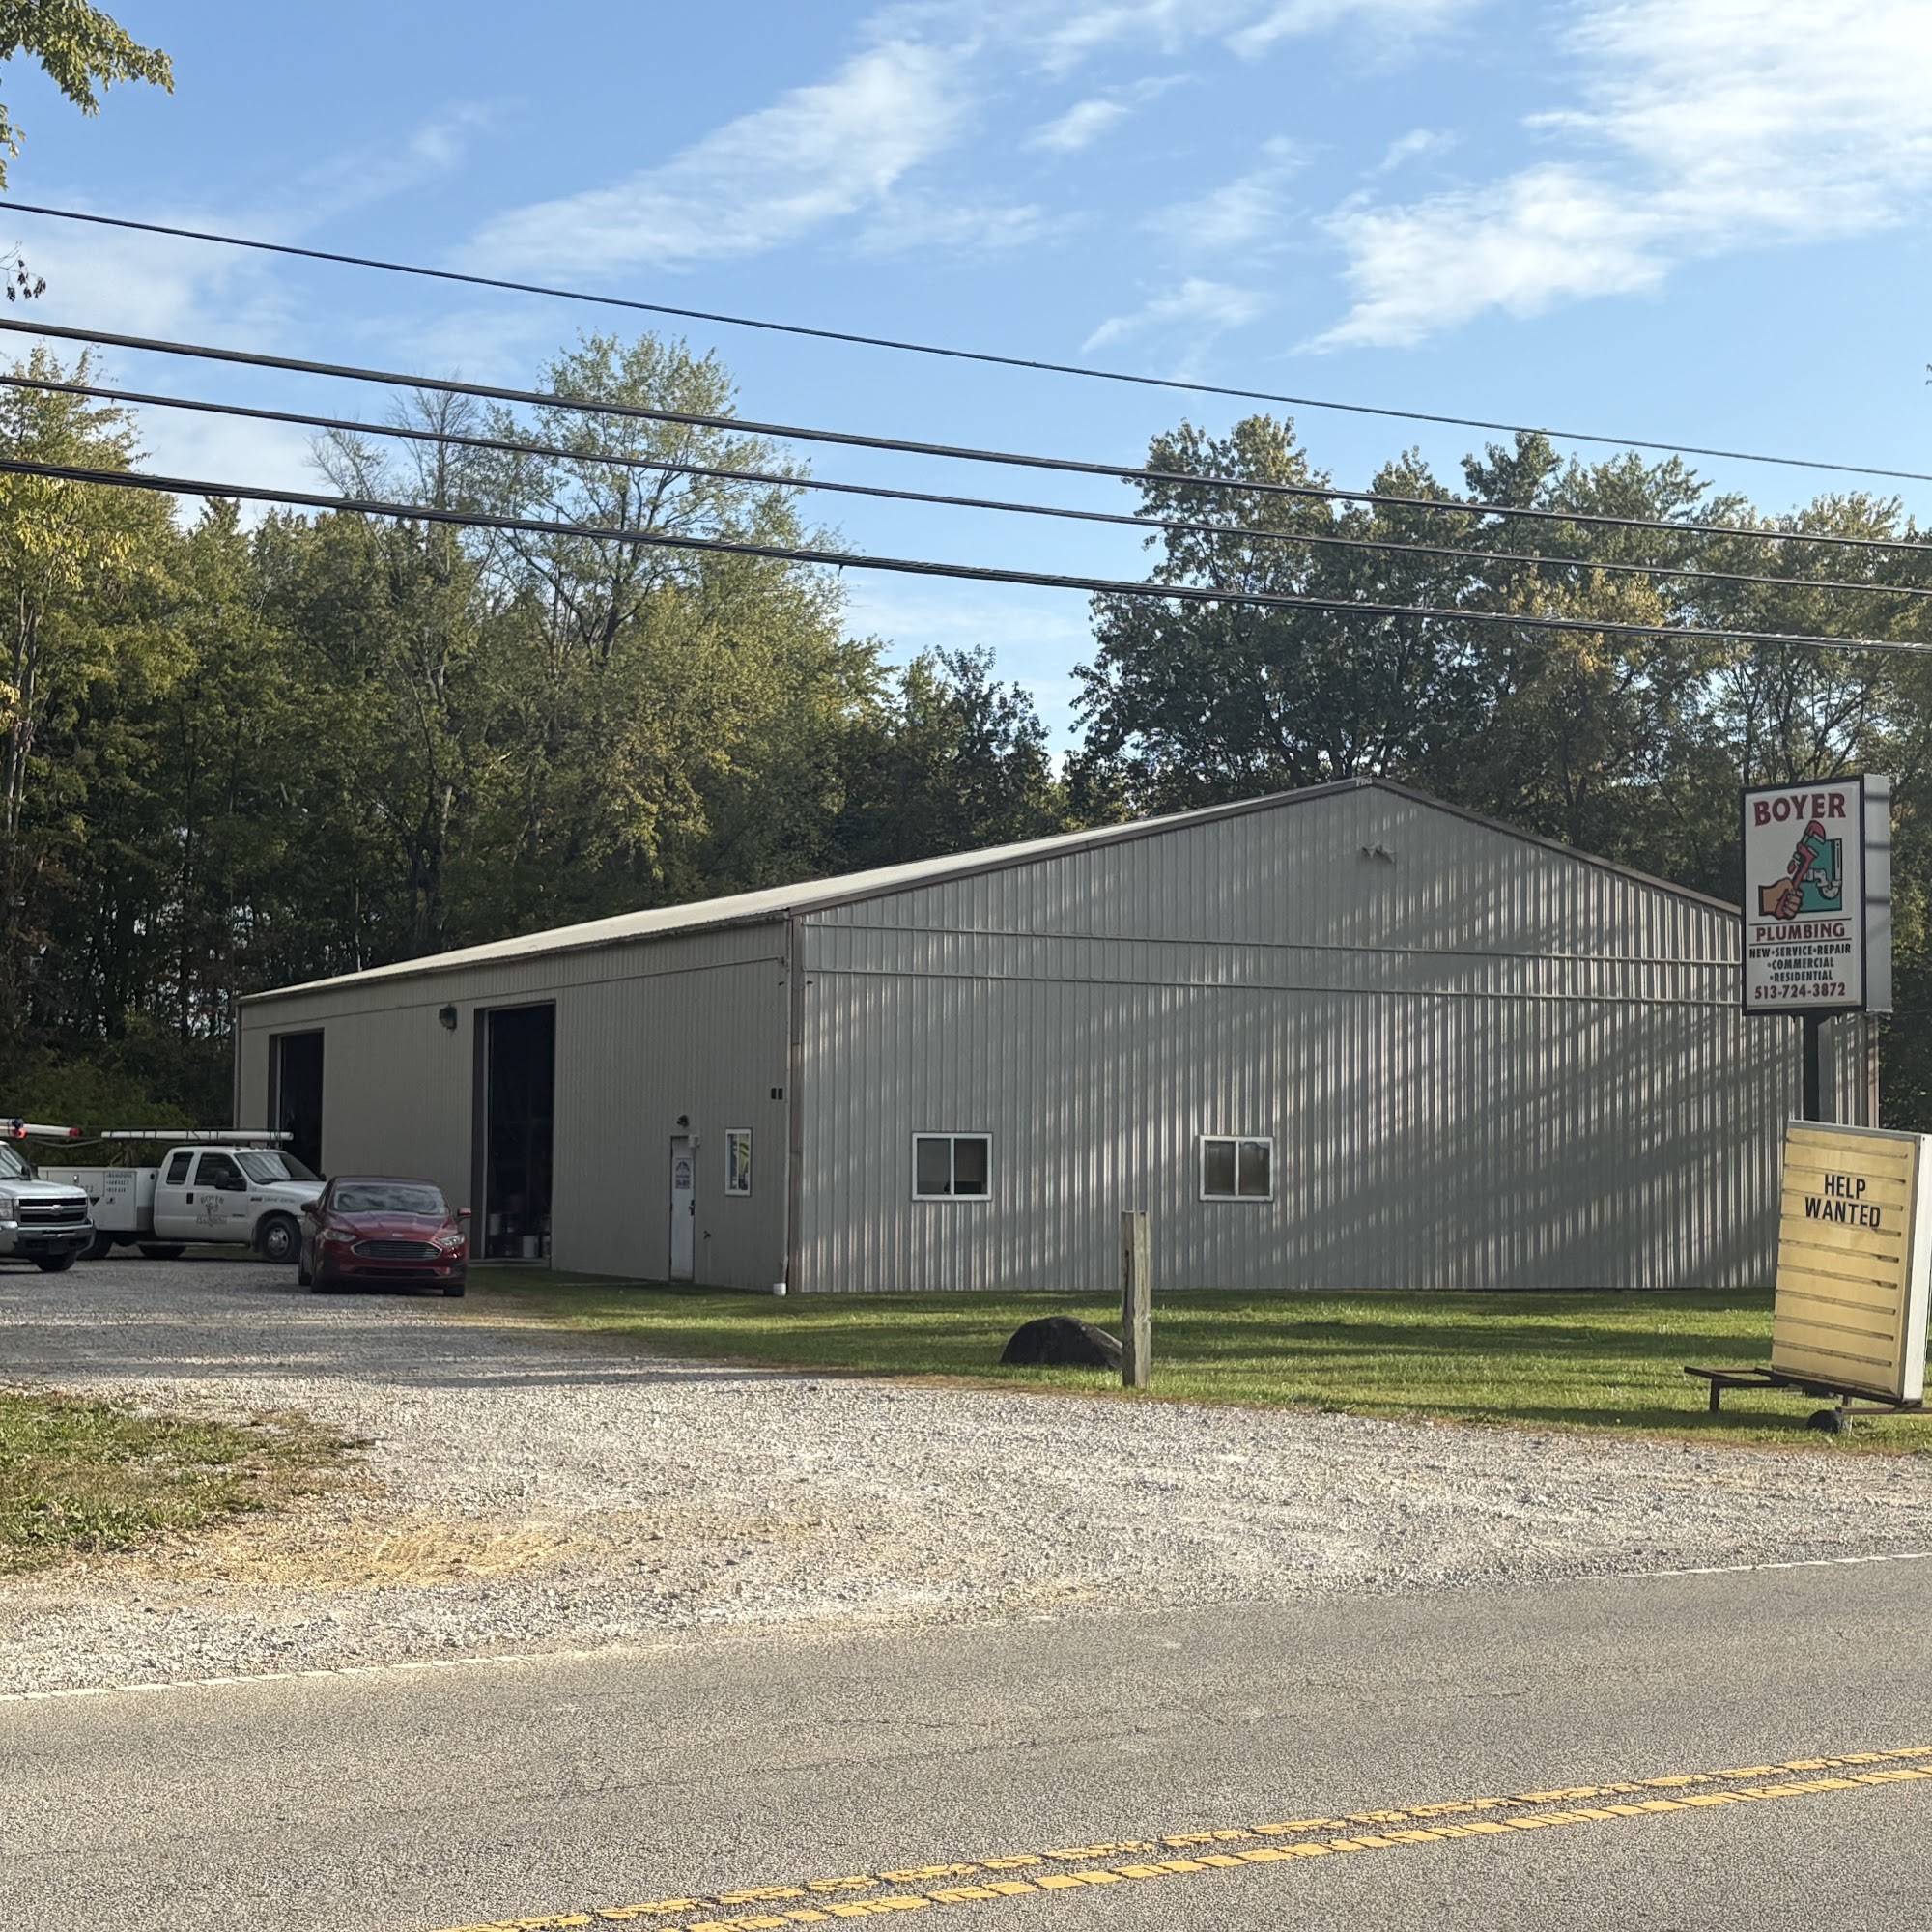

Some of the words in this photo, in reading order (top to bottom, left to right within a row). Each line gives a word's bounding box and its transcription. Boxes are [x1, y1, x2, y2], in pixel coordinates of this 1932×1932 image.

[1753, 793, 1846, 826] BOYER
[1756, 923, 1845, 942] PLUMBING
[1754, 982, 1846, 1000] 513-724-3872
[1824, 1174, 1866, 1200] HELP
[1804, 1196, 1881, 1228] WANTED
